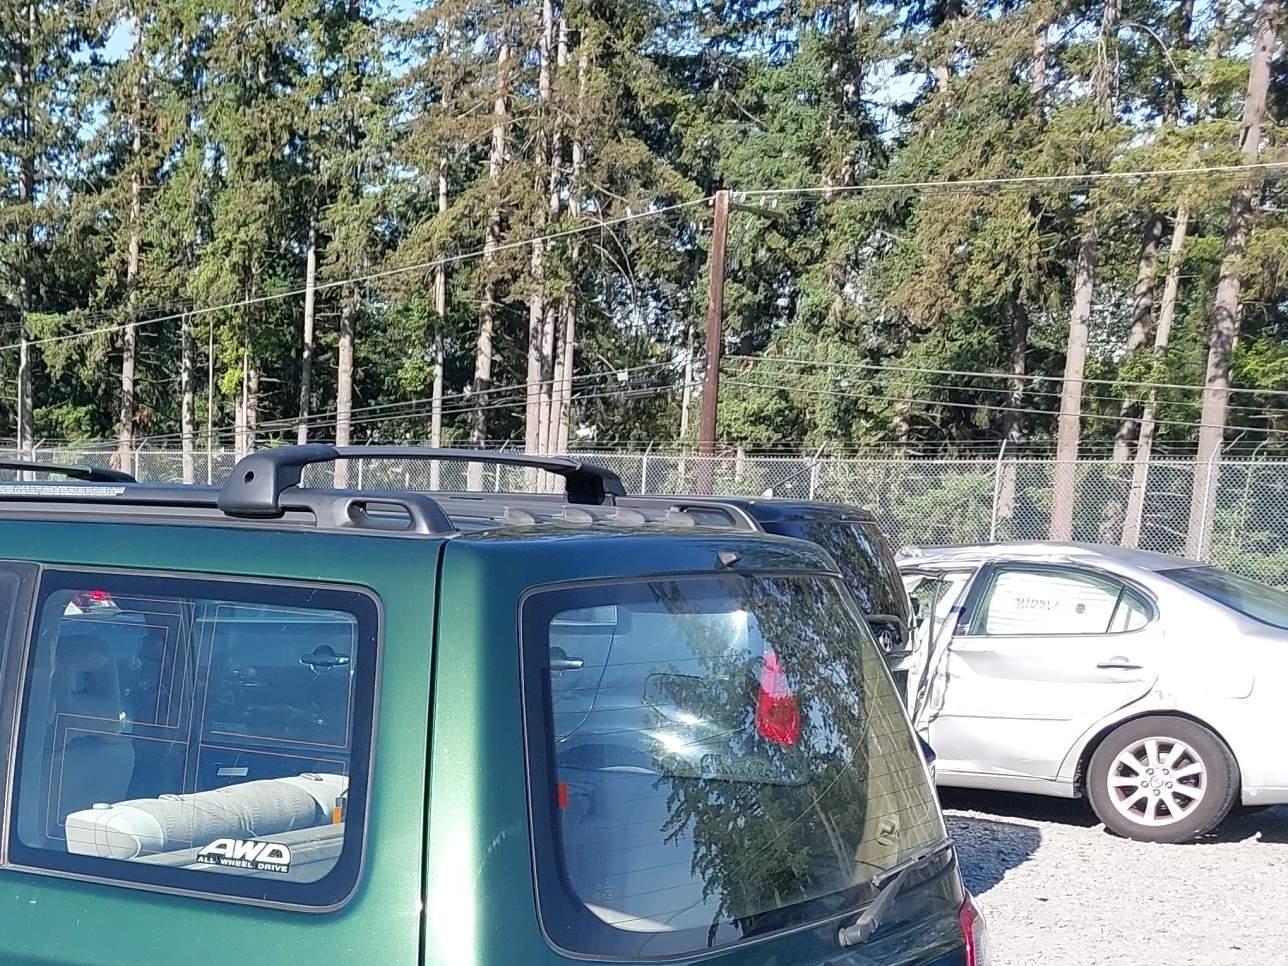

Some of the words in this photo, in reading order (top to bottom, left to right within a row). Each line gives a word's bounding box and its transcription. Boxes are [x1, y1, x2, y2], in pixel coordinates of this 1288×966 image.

[198, 838, 291, 865] AWD
[197, 856, 216, 864] ALL
[220, 859, 253, 868] WHEEL
[257, 863, 289, 873] DRIVE
